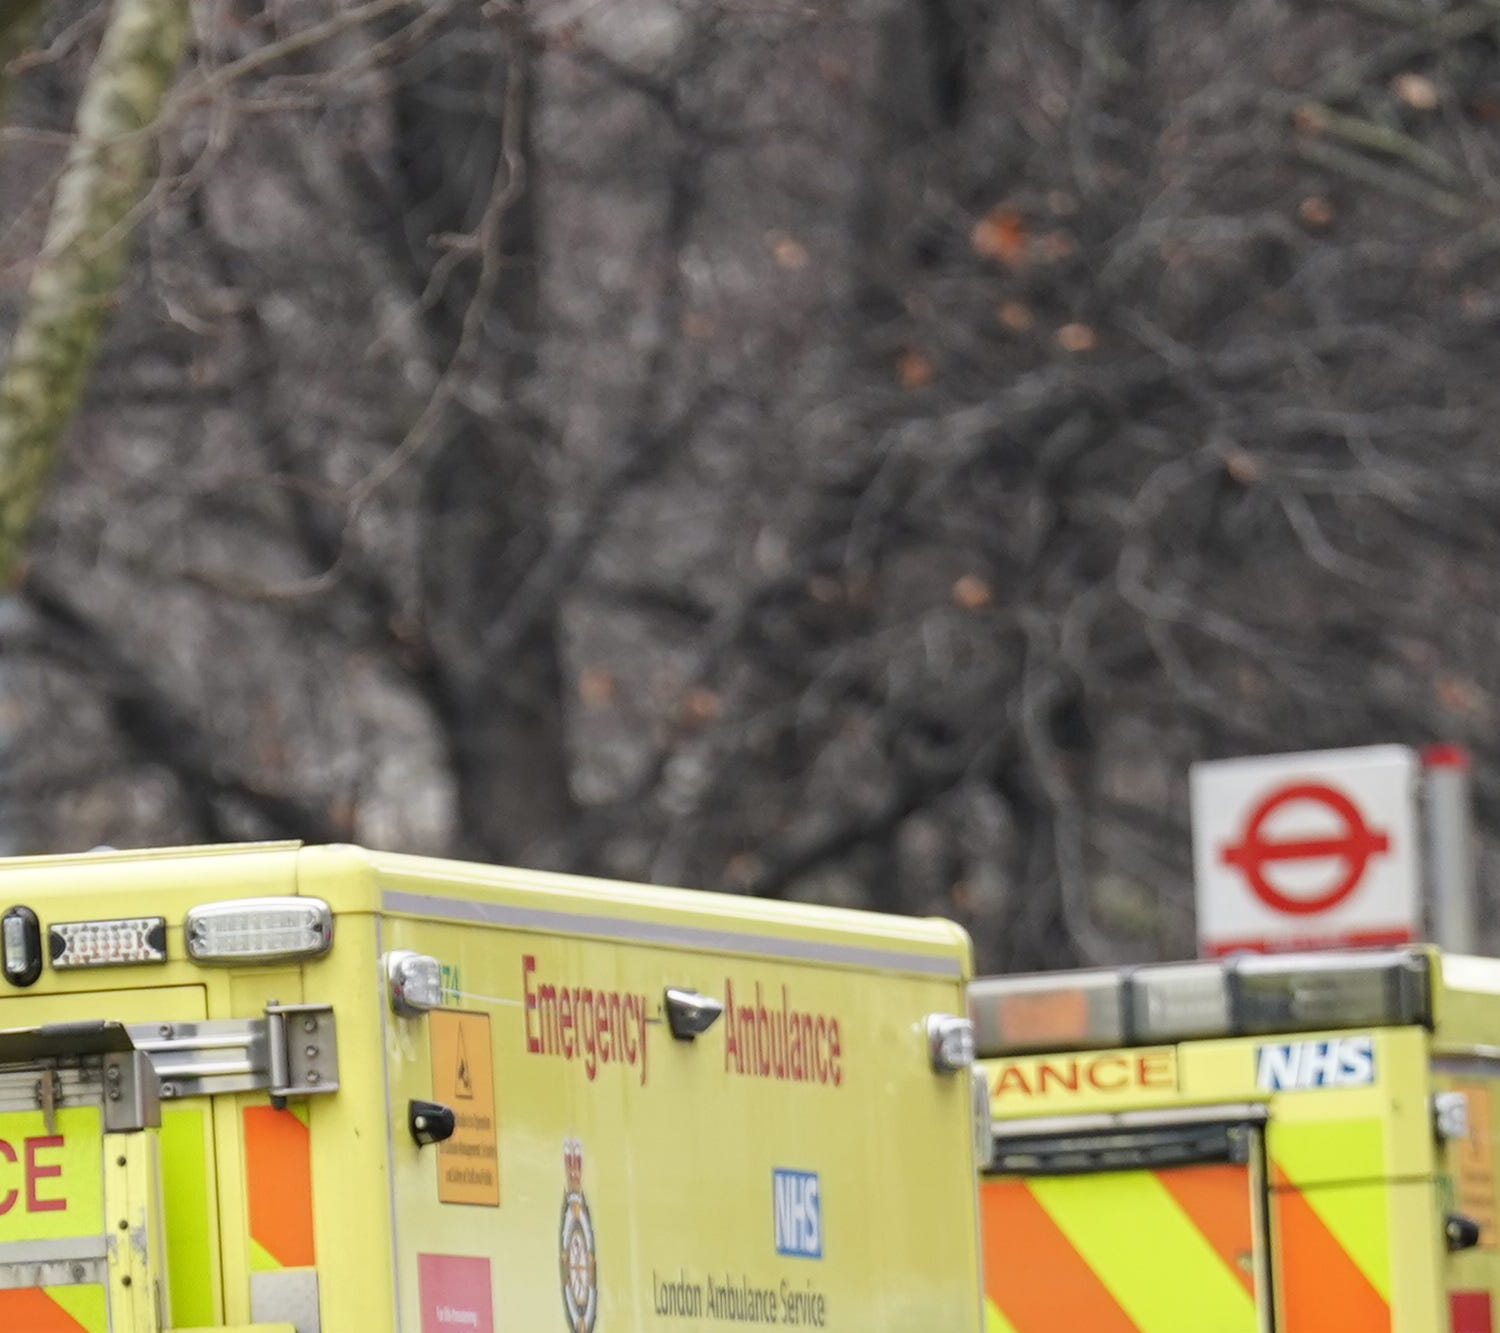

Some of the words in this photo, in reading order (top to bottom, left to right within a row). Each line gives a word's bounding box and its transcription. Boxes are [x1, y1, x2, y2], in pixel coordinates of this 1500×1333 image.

[522, 955, 651, 1086] Emergency
[725, 977, 842, 1087] Ambulance
[1256, 1039, 1374, 1091] NHS
[775, 1174, 819, 1253] NHS
[653, 1268, 702, 1318] London
[707, 1269, 778, 1324] Ambulance
[781, 1269, 825, 1327] Service
